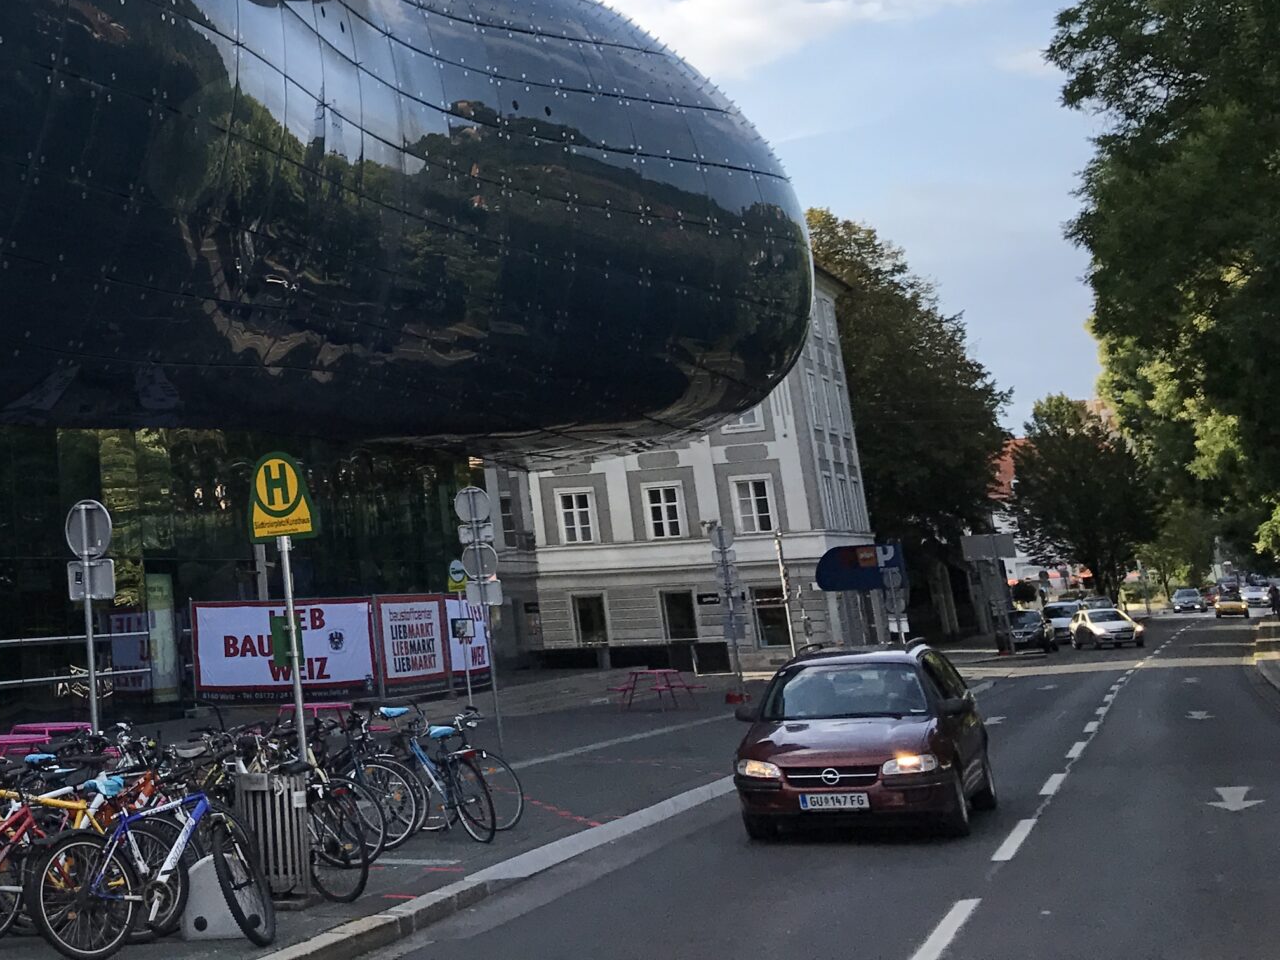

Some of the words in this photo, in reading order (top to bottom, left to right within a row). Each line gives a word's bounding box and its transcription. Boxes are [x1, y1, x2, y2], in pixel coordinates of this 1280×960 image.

[263, 463, 290, 506] H
[269, 608, 326, 631] EB
[390, 623, 434, 640] LIEBMARKT
[224, 635, 273, 658] BAU
[391, 638, 435, 656] LIEBMARKT
[393, 654, 436, 673] LIEBMARKT
[809, 796, 824, 807] GU
[830, 795, 847, 807] 147
[849, 795, 864, 806] FG
